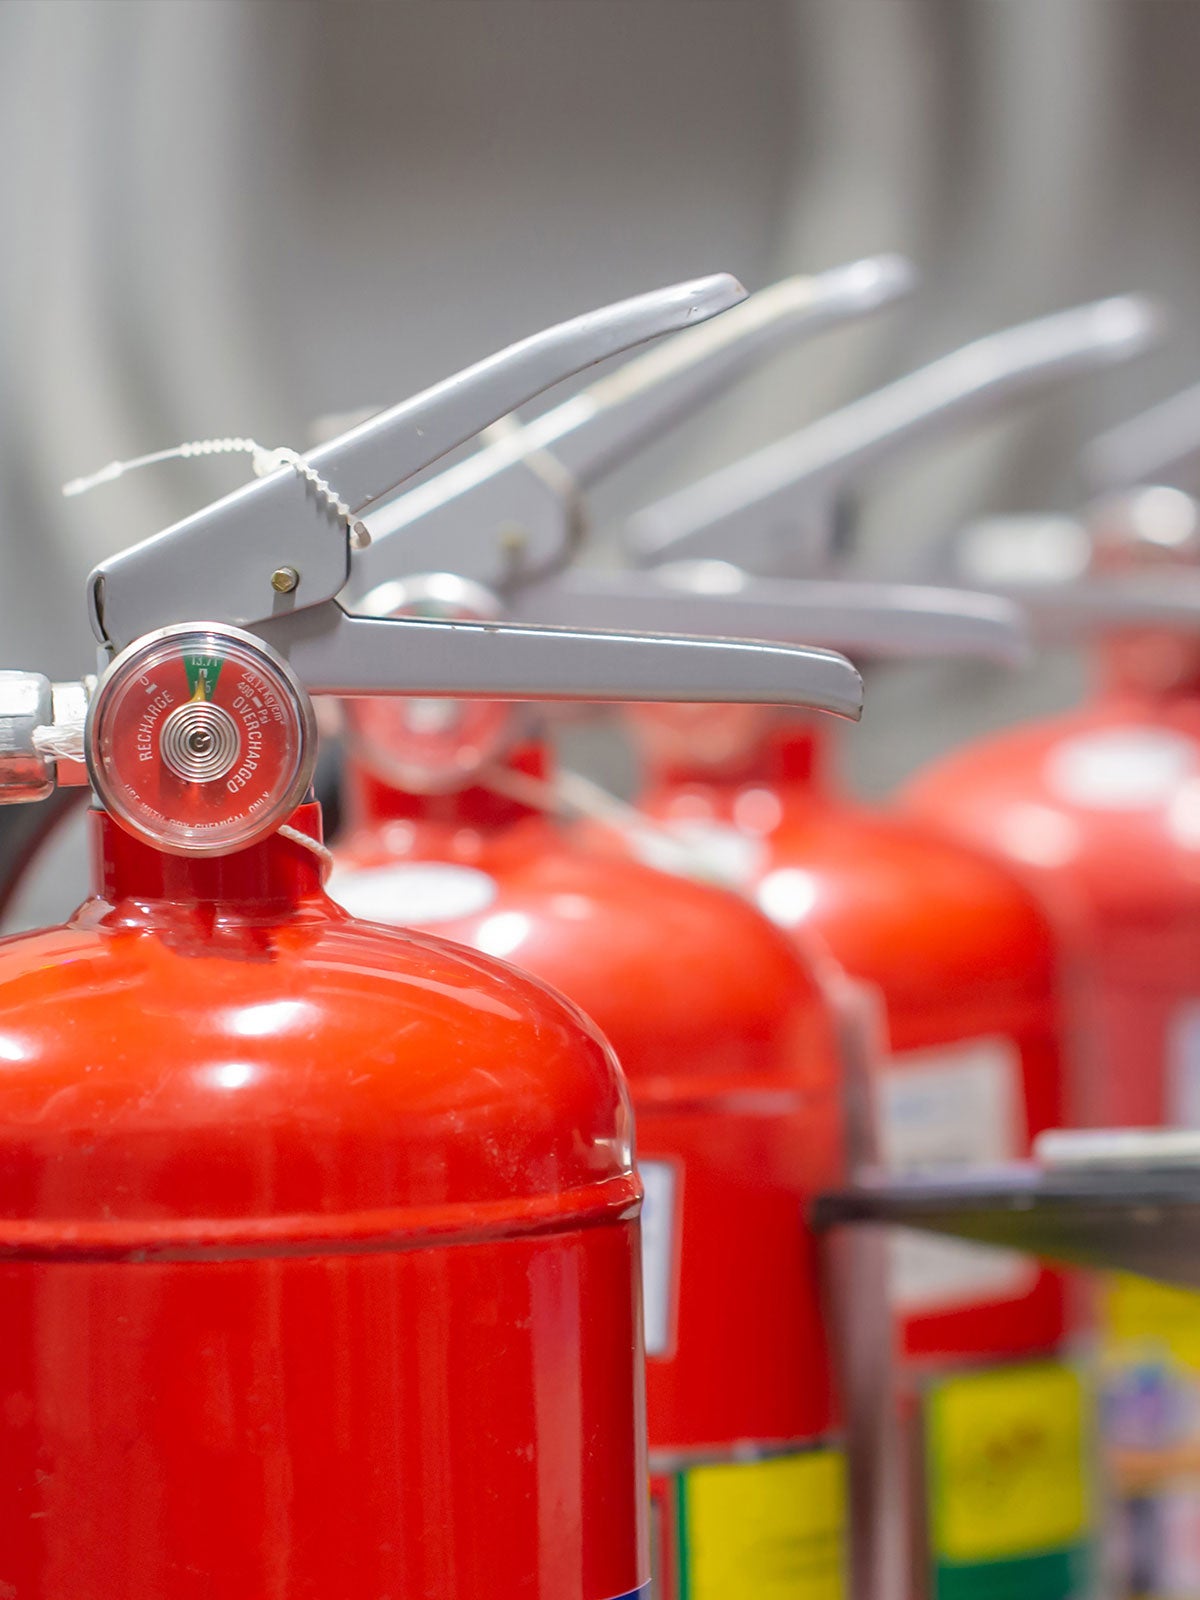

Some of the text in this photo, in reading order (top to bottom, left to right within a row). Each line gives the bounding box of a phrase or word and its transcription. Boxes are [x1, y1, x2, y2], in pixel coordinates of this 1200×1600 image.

[194, 680, 213, 693] 15
[137, 690, 174, 761] RECHARGE
[226, 697, 262, 793] OVERCHARGED
